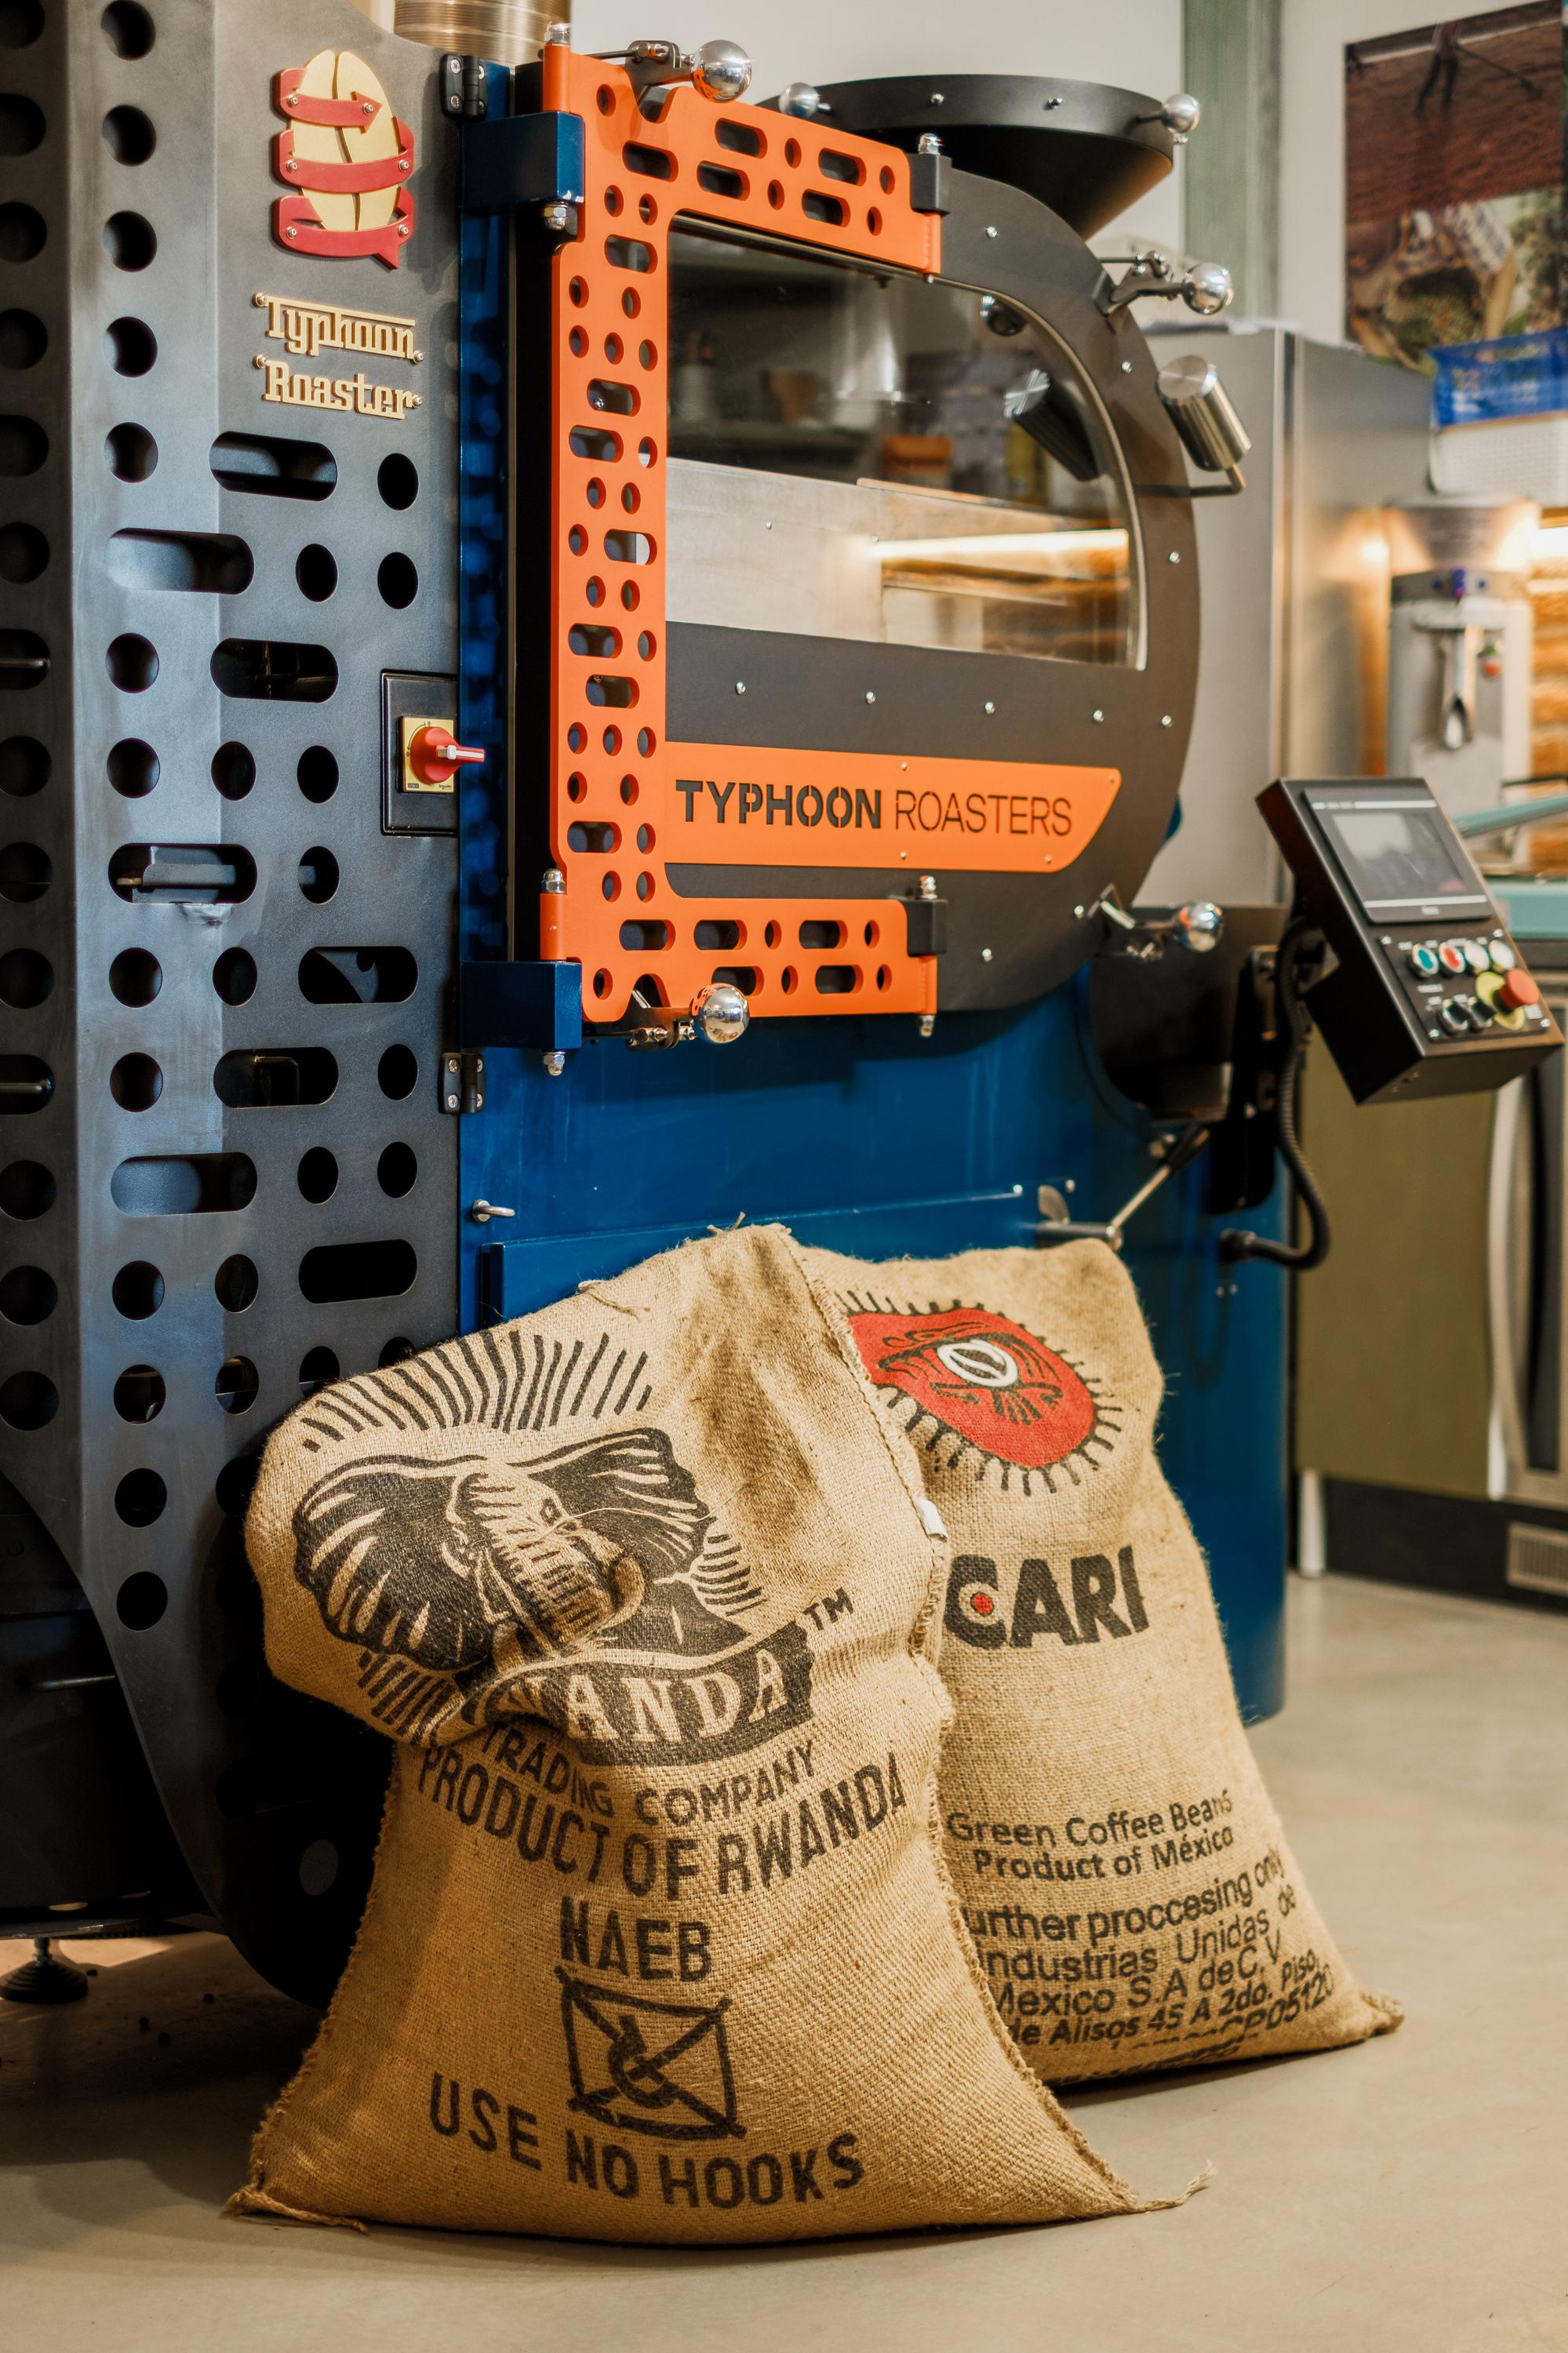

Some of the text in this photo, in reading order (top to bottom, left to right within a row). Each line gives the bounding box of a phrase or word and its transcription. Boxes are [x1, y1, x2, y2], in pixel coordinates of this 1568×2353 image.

[264, 295, 416, 359] Typhoon
[262, 360, 414, 419] Roaster
[675, 780, 1072, 837] TYPHOON ROASTERS
[803, 1587, 854, 1631] TM
[944, 1545, 1149, 1649] CARI
[482, 1726, 817, 1827] TRADING COMPANY
[418, 1747, 907, 1901] PRODUCT OF RWANDA
[947, 1788, 1233, 1848] Green Coffee Beans
[973, 1826, 1234, 1882] Product of México
[559, 1896, 711, 1982] NAEB
[962, 1904, 1081, 1941] urther
[1087, 1871, 1253, 1949] proccesing
[1177, 1908, 1270, 1964] Unidas
[1048, 2016, 1141, 2046] Alisos
[430, 2072, 864, 2209] USE NO HOOKS
